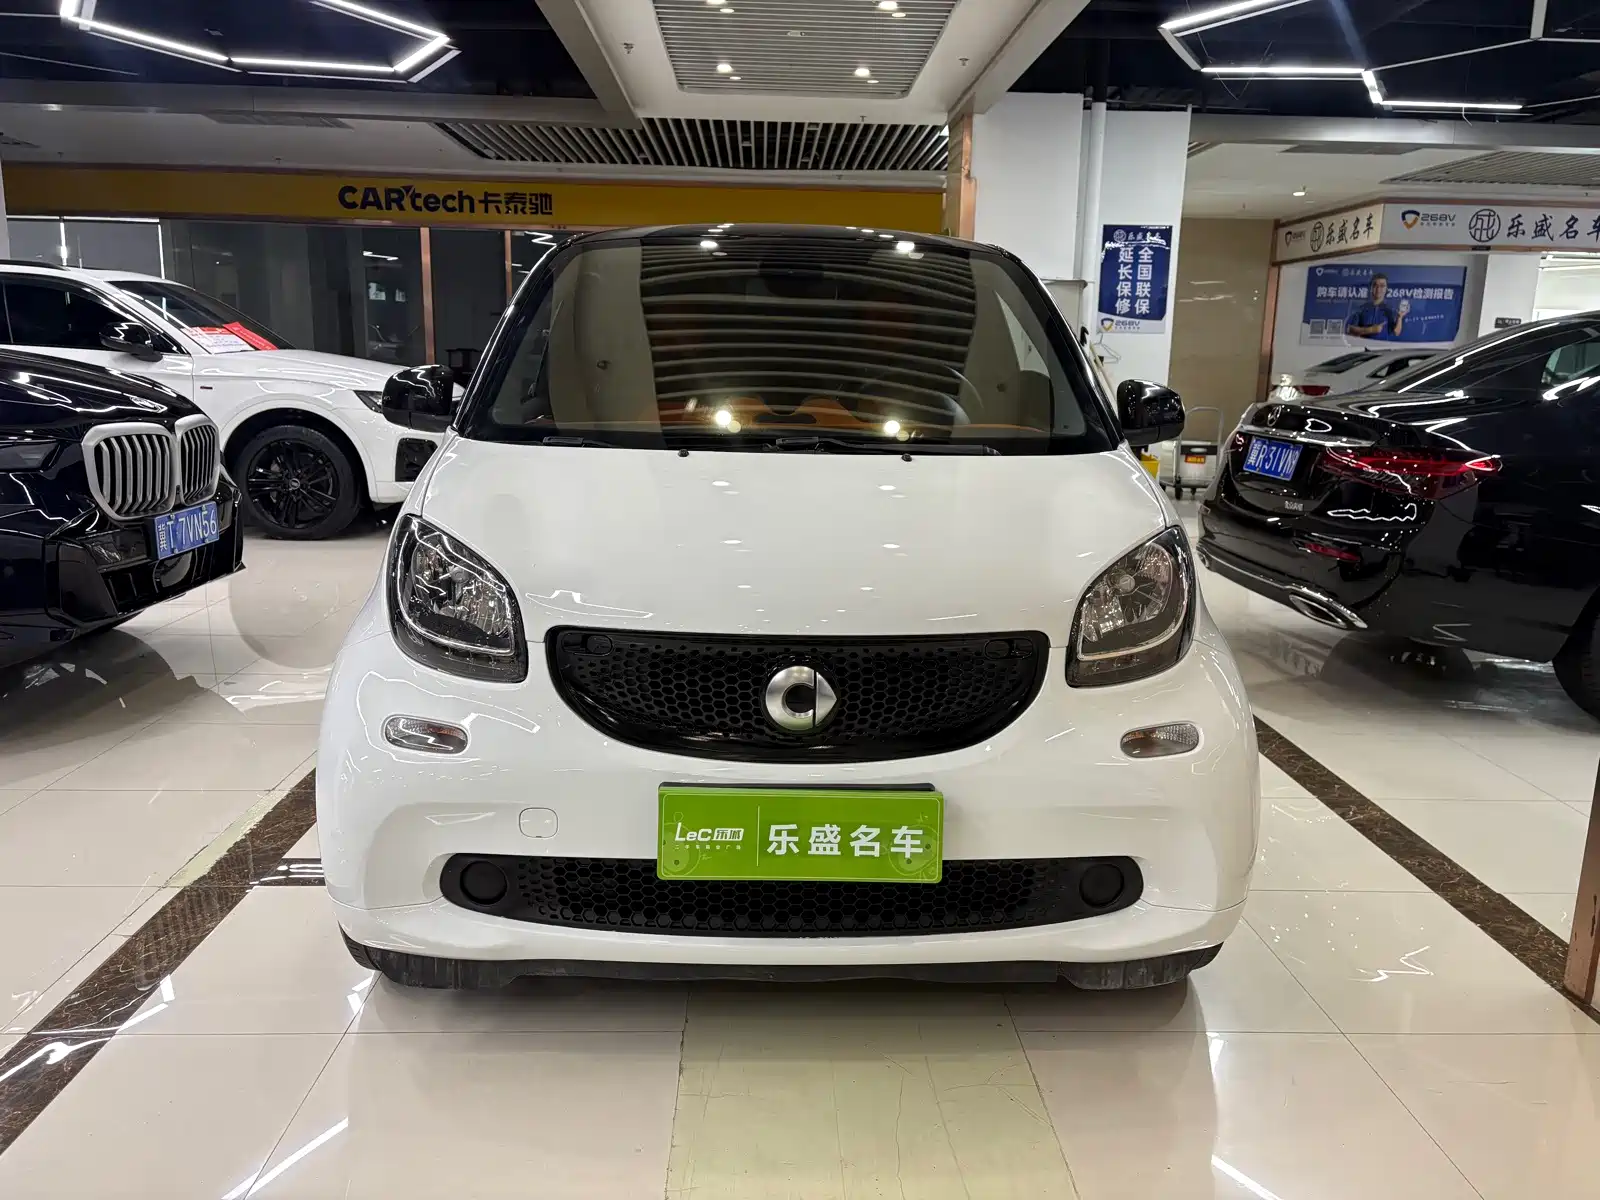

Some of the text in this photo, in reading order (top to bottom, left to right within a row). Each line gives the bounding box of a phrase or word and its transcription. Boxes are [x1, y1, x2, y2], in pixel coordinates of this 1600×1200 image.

[479, 191, 552, 215] 卡泰驰
[1420, 213, 1456, 222] 268V
[1115, 246, 1134, 315] 延长保修
[1134, 246, 1154, 315] 全国联保
[1316, 286, 1368, 299] 购车请认准
[766, 823, 924, 859] 乐盛名车
